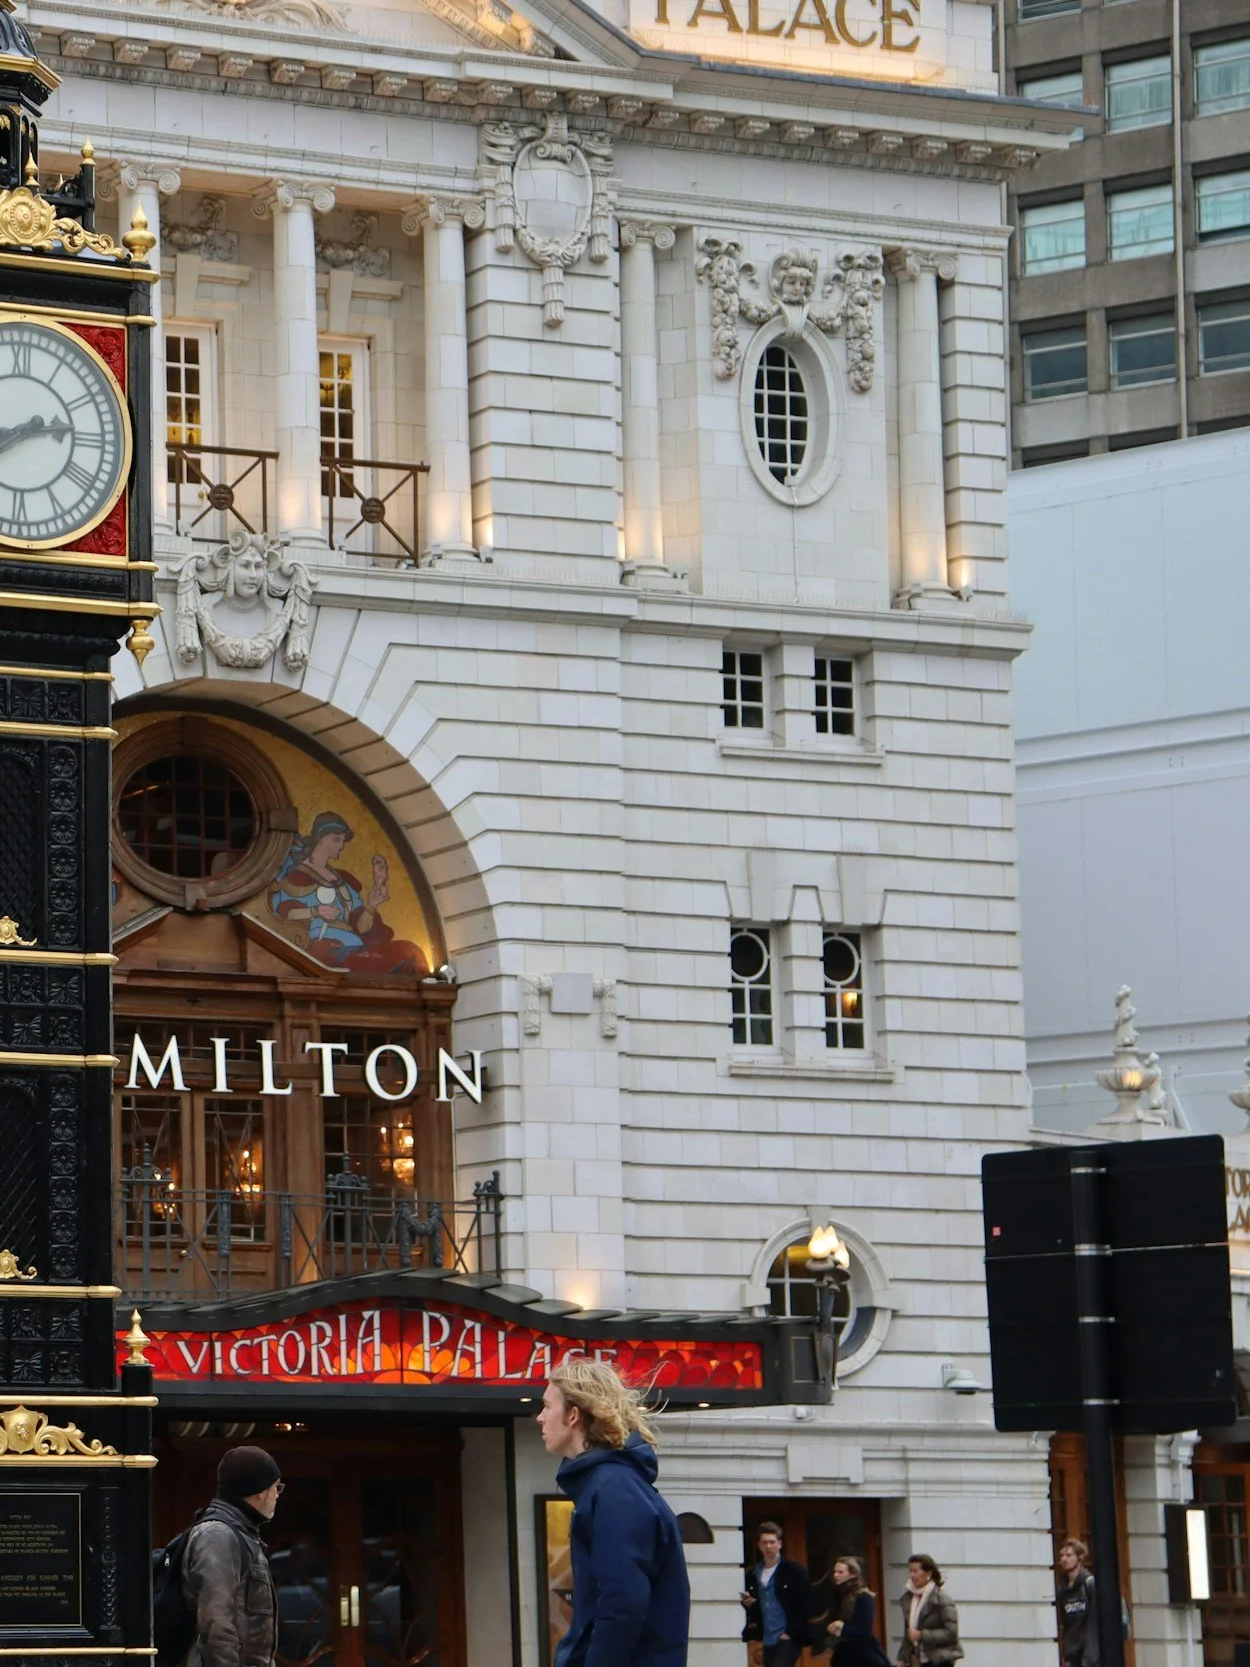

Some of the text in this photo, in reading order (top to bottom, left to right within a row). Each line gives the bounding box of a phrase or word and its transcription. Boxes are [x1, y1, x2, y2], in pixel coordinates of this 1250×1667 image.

[11, 344, 32, 376] XII
[124, 1032, 483, 1104] MILTON
[176, 1310, 382, 1376] VICTORIA
